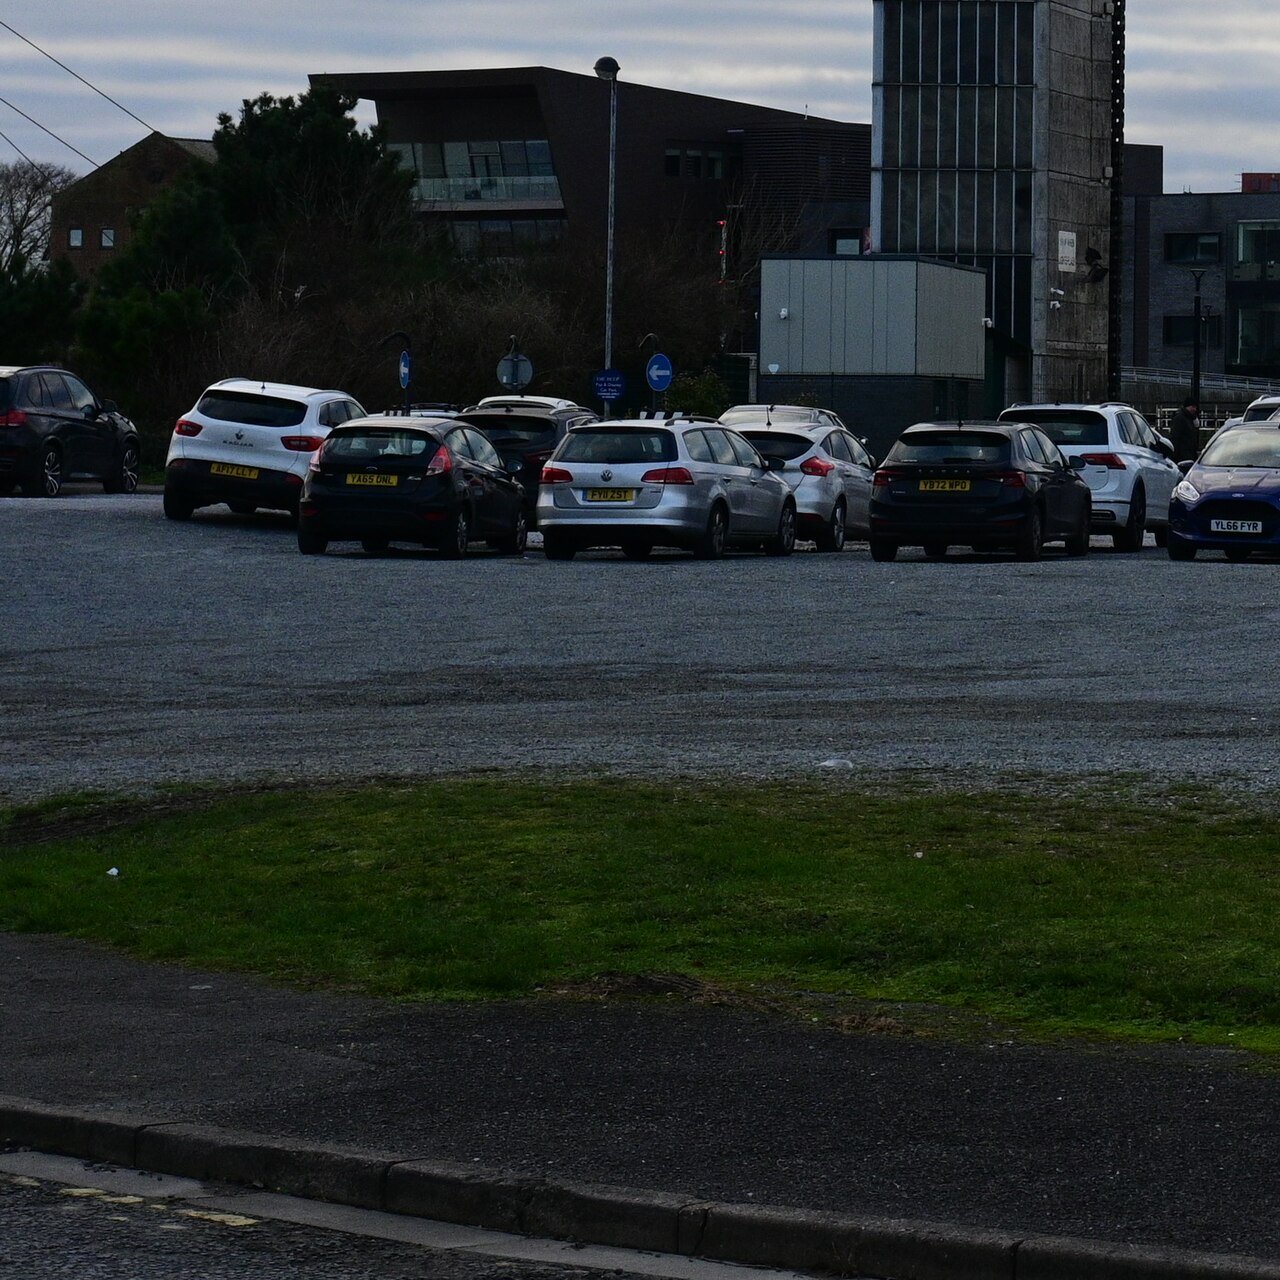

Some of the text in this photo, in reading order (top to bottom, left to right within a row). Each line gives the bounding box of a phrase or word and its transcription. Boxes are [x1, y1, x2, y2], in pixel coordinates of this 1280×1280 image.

[610, 490, 629, 499] ZST
[1215, 521, 1259, 531] YL66 FYR
